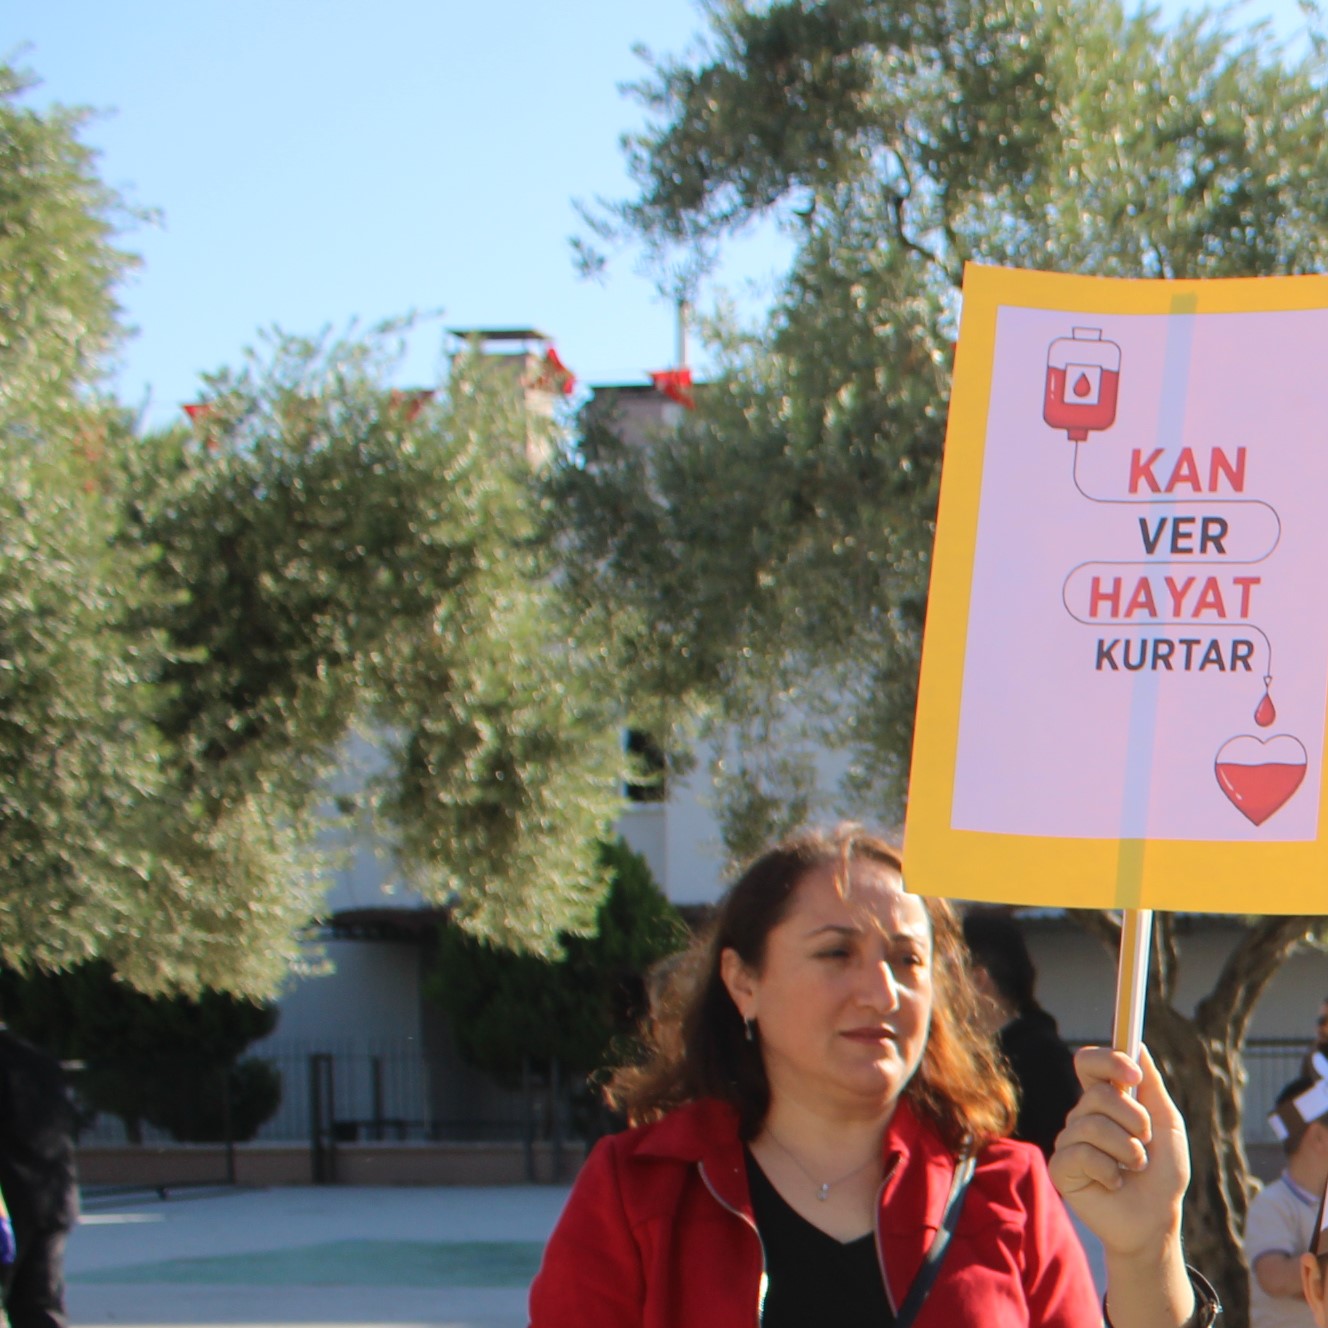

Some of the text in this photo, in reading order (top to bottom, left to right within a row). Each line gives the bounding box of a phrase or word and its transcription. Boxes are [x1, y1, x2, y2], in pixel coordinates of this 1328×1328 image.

[1127, 446, 1247, 494] KAN
[1137, 516, 1229, 555] VER
[1088, 575, 1261, 619] HAYAT
[1095, 638, 1255, 672] KURTAR
